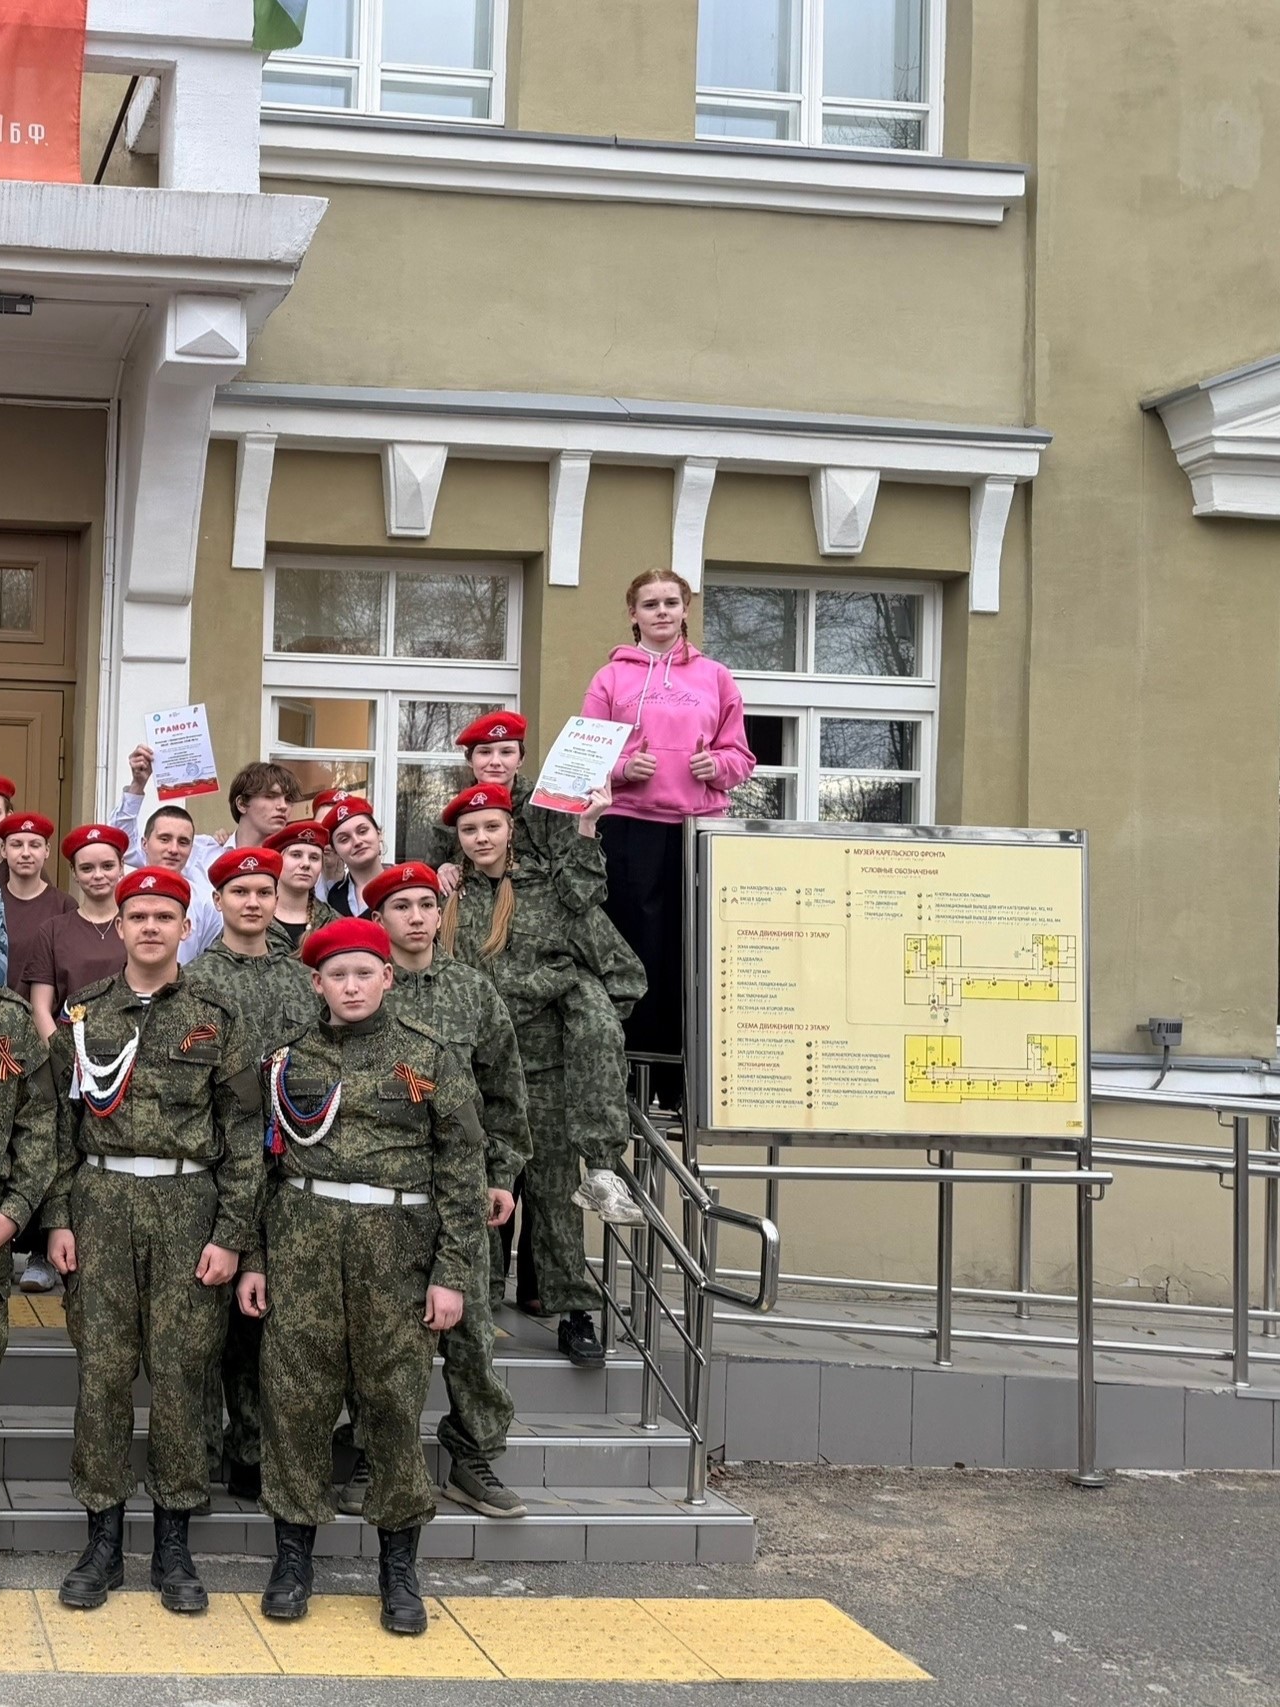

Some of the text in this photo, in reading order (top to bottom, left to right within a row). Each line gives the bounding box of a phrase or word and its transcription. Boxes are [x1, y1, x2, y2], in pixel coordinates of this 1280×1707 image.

[155, 721, 198, 735] ГРАМОТА
[568, 731, 613, 745] ГРАМОТА
[853, 848, 946, 859] МУЗЕЙ КАРЕЛЬСКОГО ФРОНТА
[861, 866, 939, 876] УСЛОВНЫЕ ОБОЗНАЧЕНИЯ
[759, 1023, 794, 1031] ДВИЖЕНИЯ
[810, 1024, 831, 1032] ЭТАЖУ
